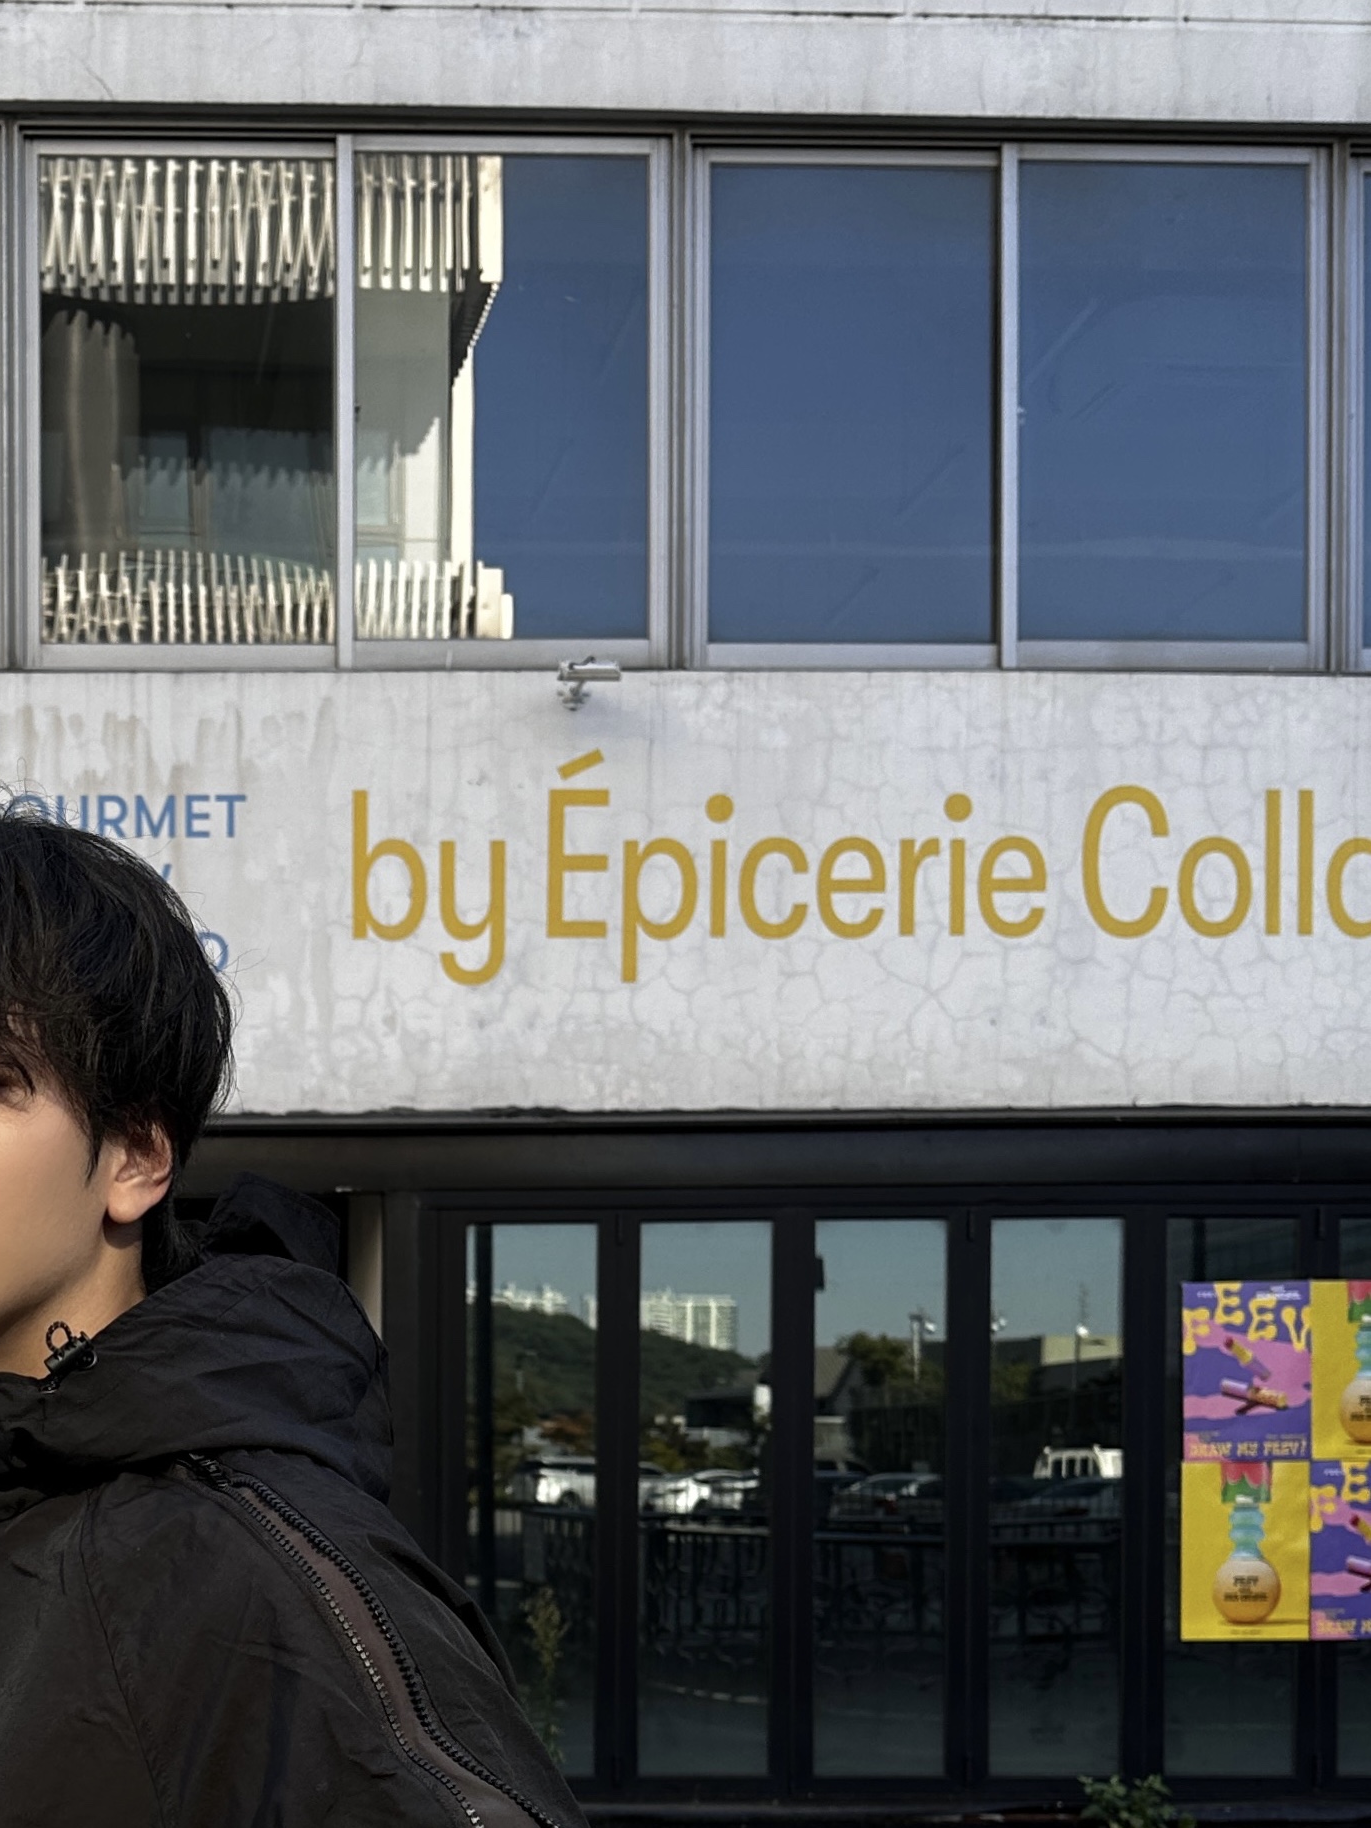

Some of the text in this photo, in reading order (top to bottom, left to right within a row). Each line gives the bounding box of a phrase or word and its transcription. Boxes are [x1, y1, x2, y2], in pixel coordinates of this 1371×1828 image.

[351, 789, 506, 986] by
[545, 748, 1048, 984] Épicerie
[1183, 1282, 1310, 1355] FEEV
